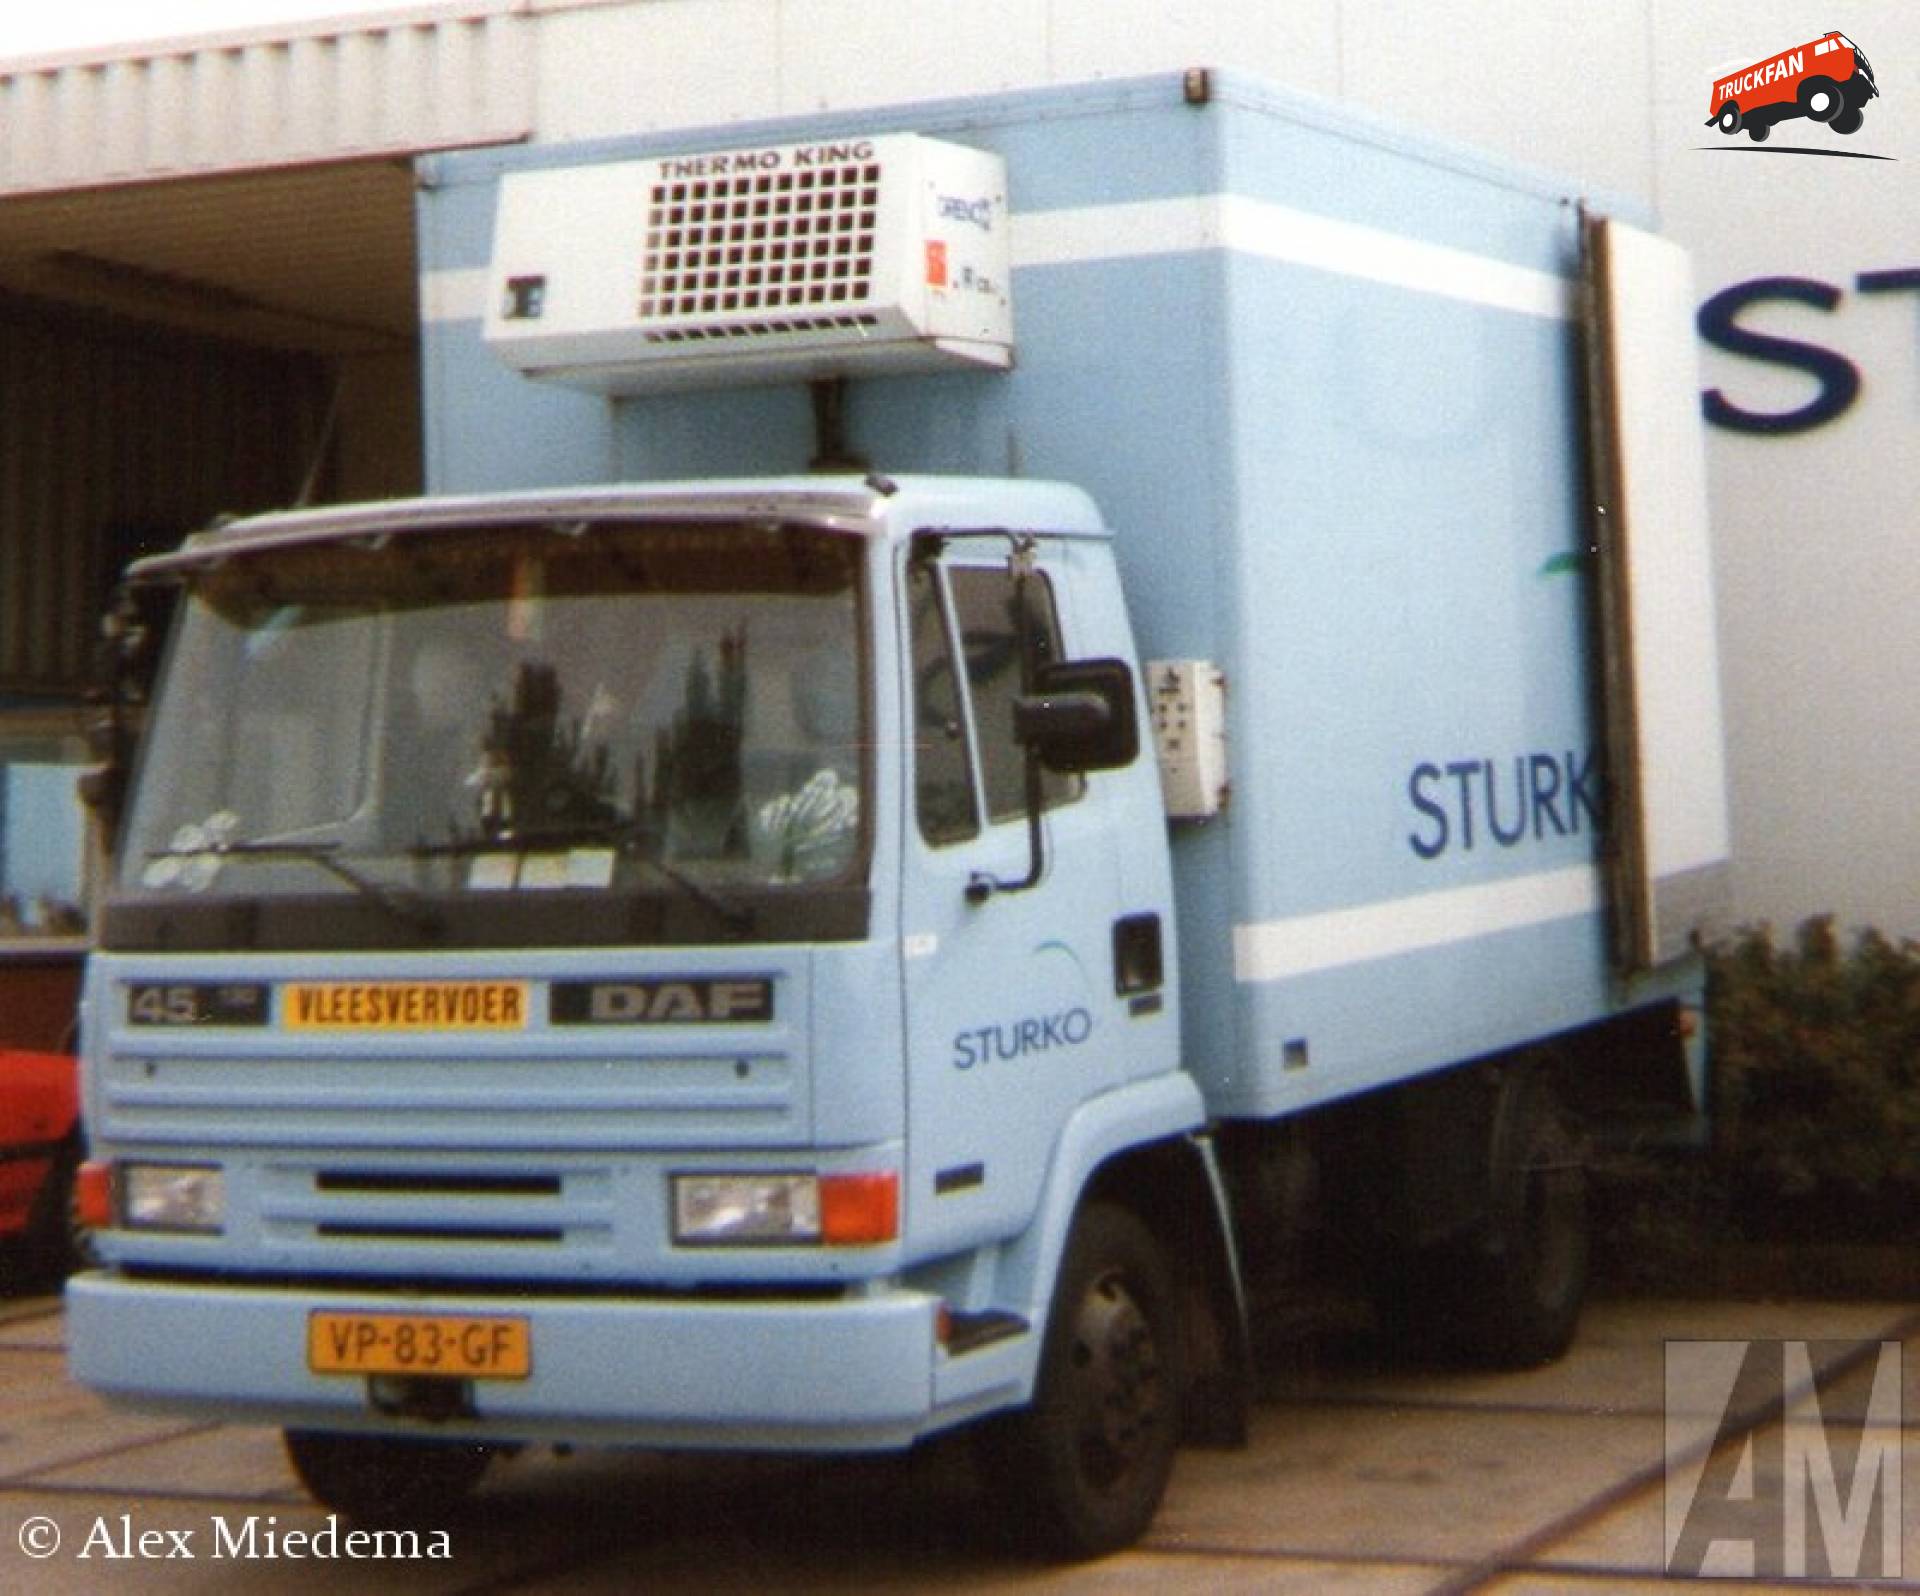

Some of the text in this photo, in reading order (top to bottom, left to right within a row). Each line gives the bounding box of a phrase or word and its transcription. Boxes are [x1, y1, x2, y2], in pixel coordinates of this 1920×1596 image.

[660, 141, 874, 178] THERMO KING
[131, 987, 196, 1023] 45
[297, 985, 522, 1024] VLEESVERVOER
[592, 984, 764, 1020] DAF
[953, 1007, 1093, 1070] STURKO
[329, 1320, 514, 1367] VP-83-GF
